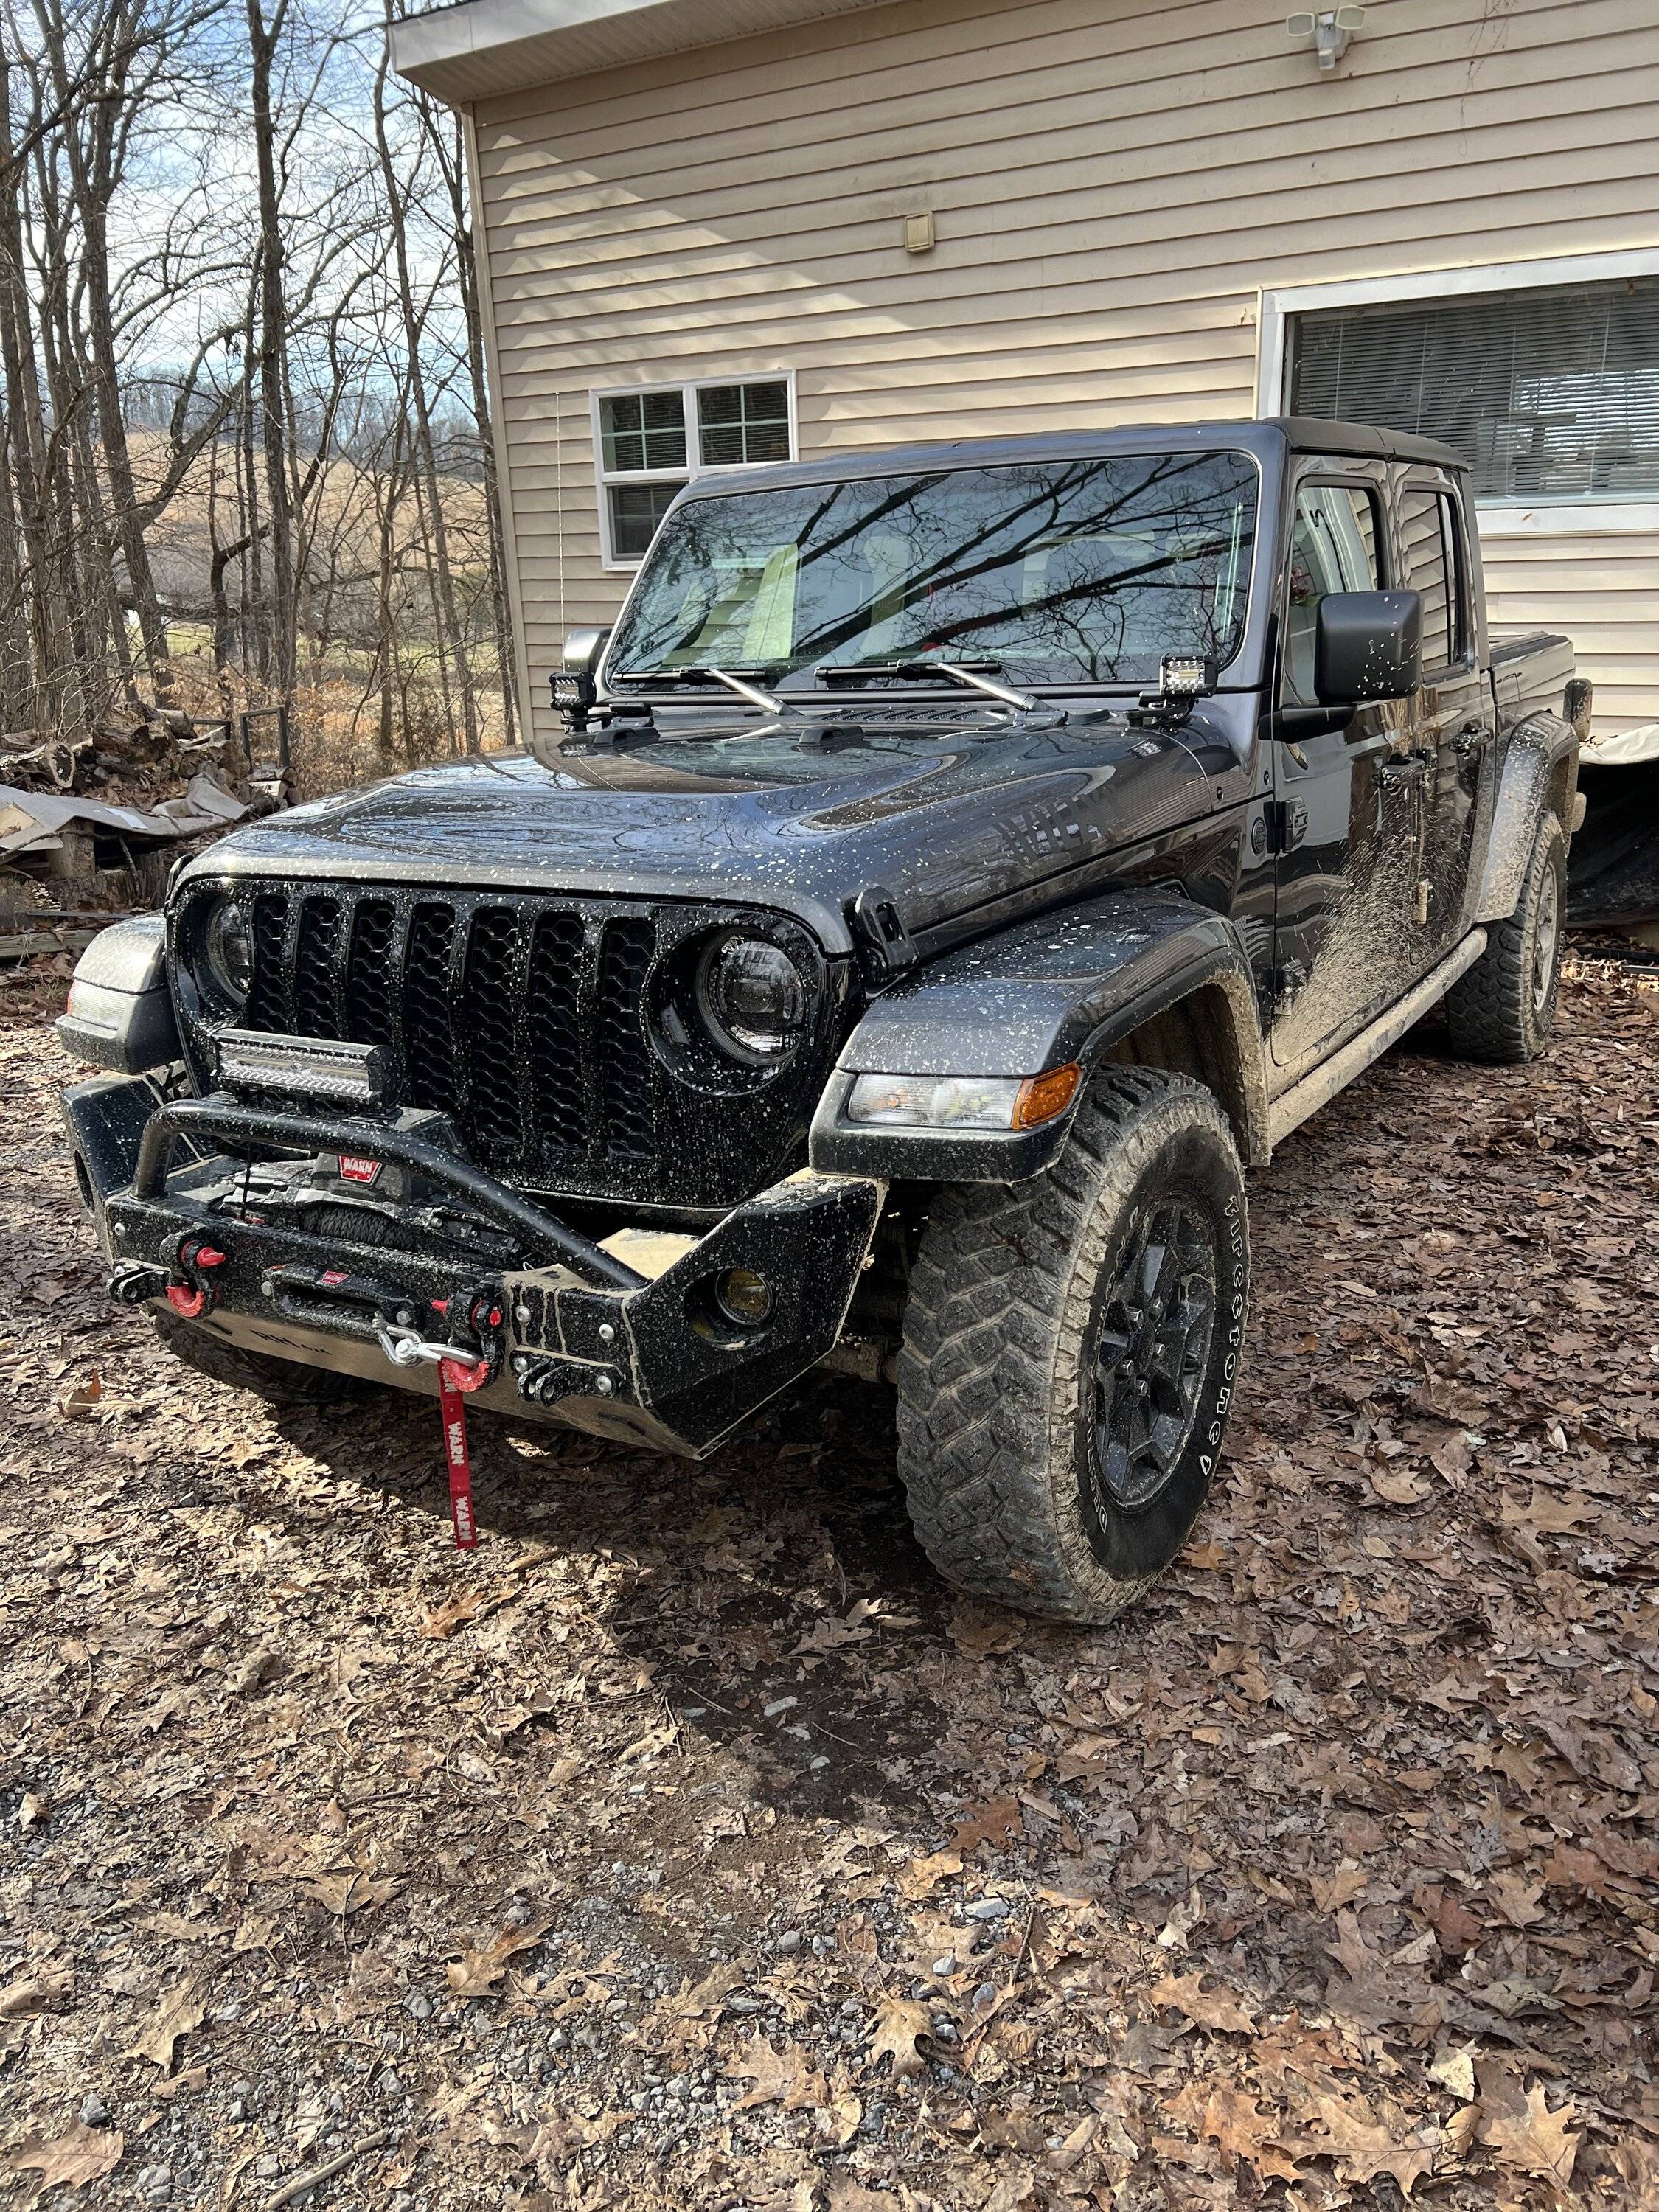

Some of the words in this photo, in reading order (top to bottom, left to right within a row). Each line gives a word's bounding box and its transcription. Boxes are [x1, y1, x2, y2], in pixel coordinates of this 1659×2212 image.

[343, 1157, 373, 1173] WARN
[448, 1421, 465, 1464] WARN
[455, 1496, 473, 1541] WARN
